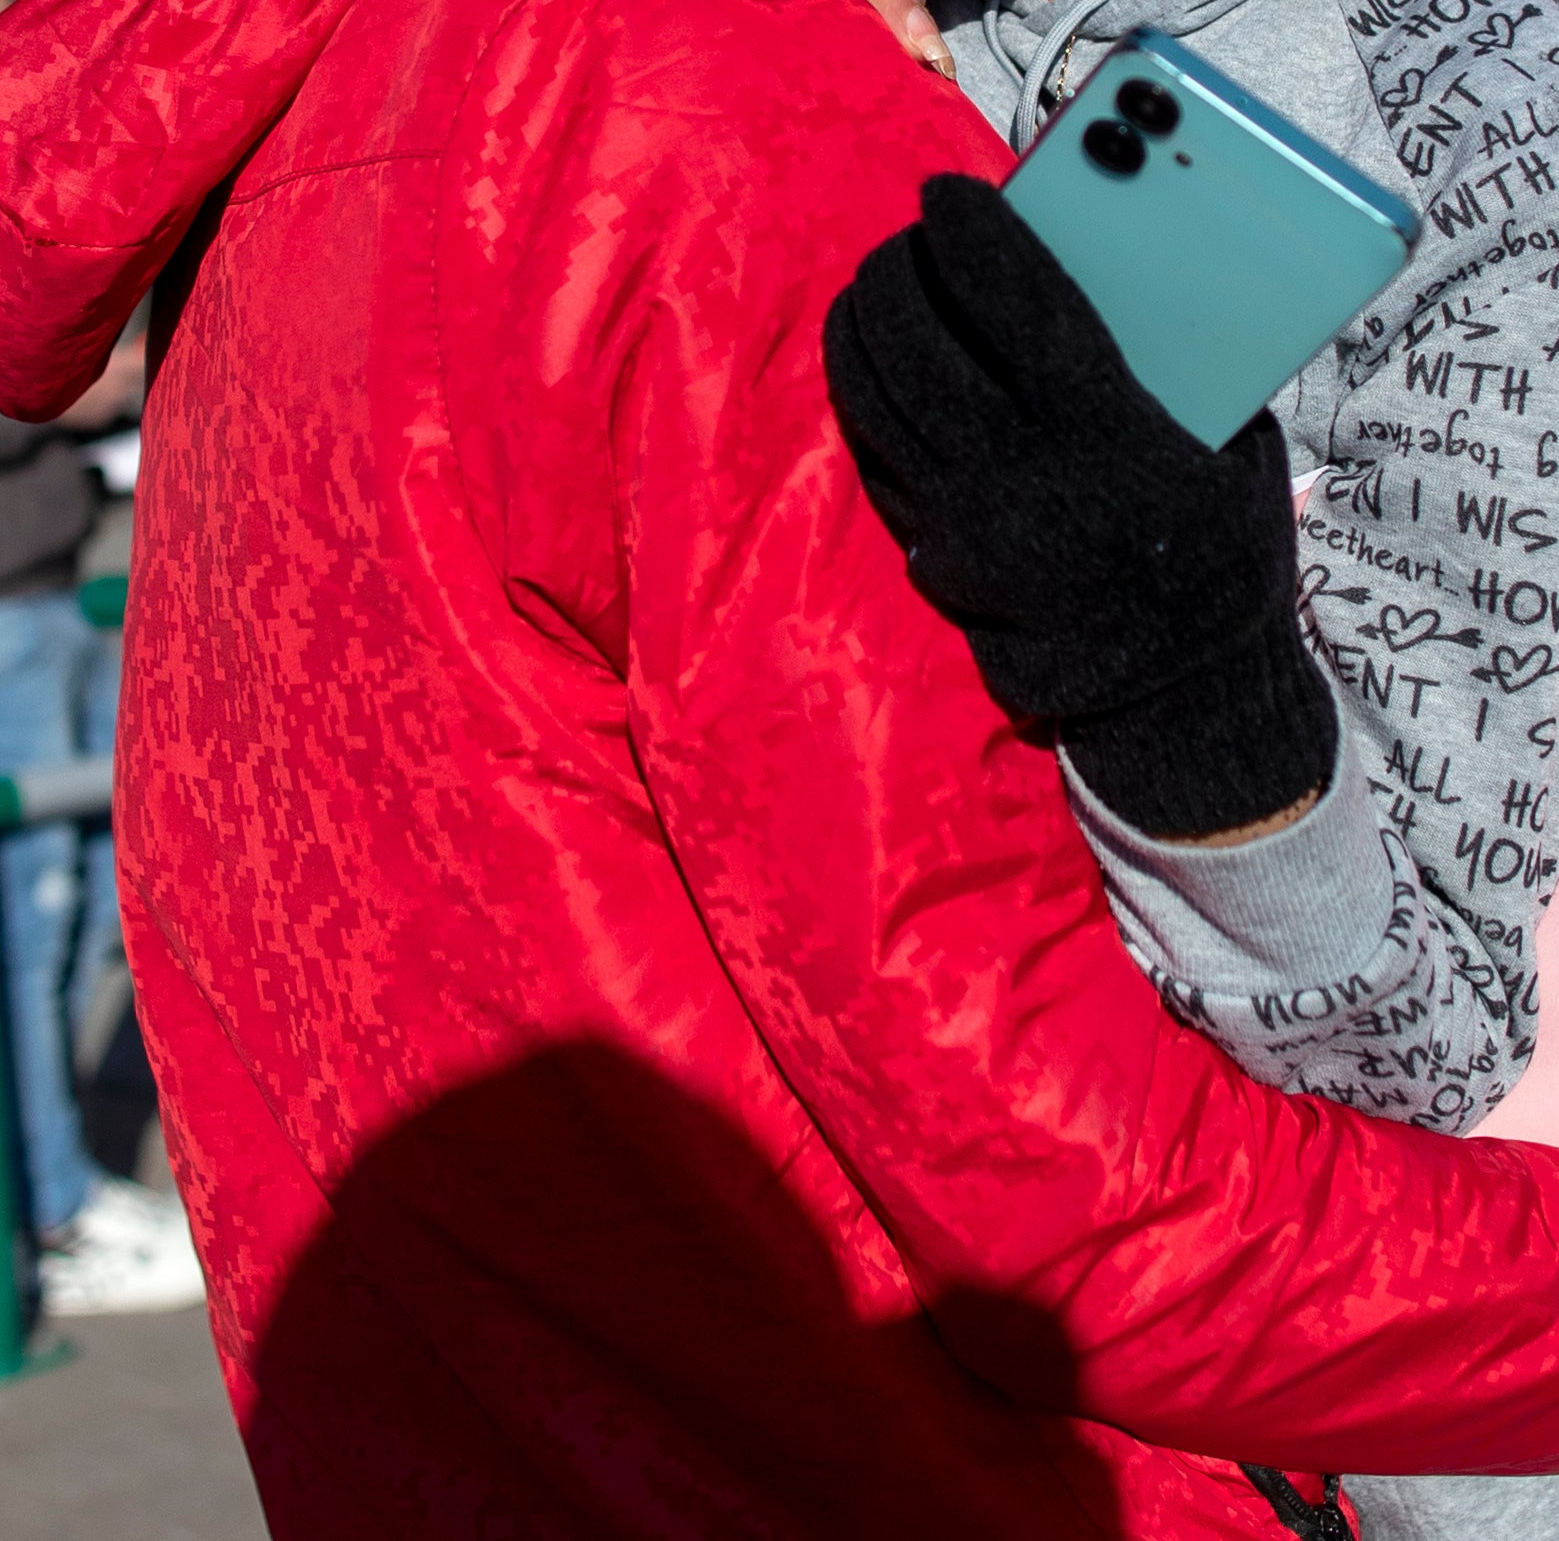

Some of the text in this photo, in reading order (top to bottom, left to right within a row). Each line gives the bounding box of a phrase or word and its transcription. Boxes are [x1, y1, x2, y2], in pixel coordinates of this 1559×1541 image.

[1477, 101, 1559, 158] ALL
[1429, 151, 1554, 239] WITH
[1405, 349, 1533, 415] WITH
[1357, 409, 1504, 480] together
[1383, 739, 1461, 805] ALL
